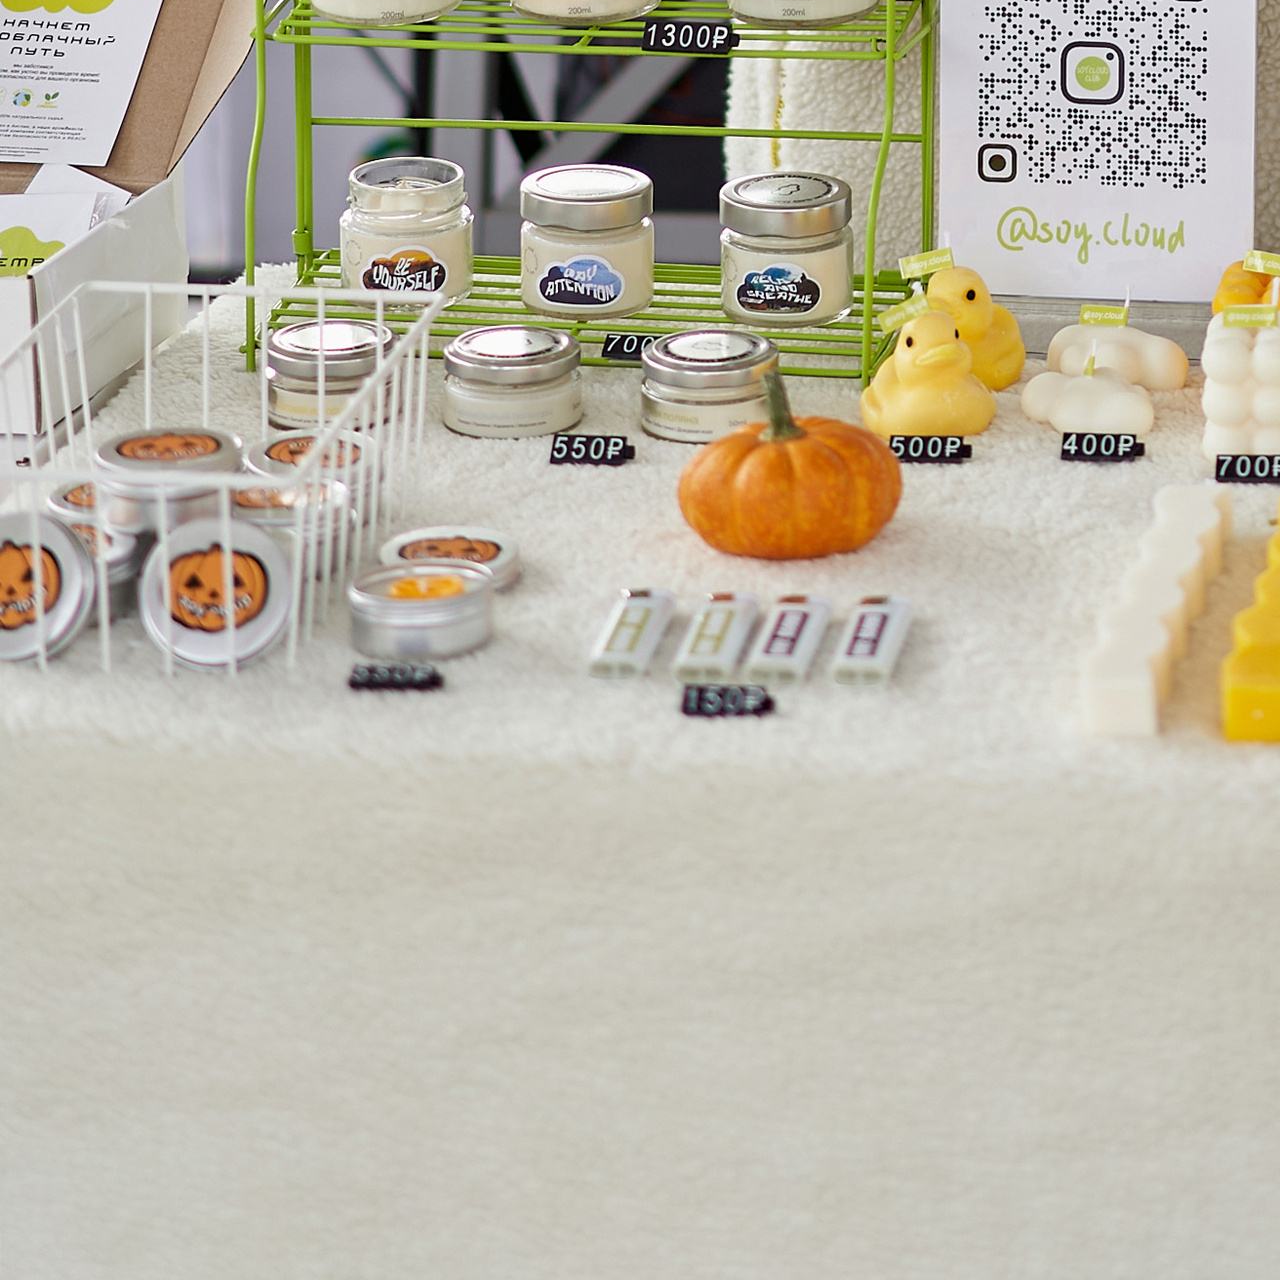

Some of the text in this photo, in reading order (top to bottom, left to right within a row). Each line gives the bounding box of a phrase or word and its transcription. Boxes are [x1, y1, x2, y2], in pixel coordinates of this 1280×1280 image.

[380, 10, 405, 20] 200ml
[567, 6, 592, 15] 200ml
[781, 8, 806, 17] 200ml
[3, 18, 91, 32] НАЧНЕМ
[0, 31, 116, 46] ОБЛАЧНЫЙ
[647, 23, 729, 49] 1300₽
[10, 46, 65, 58] ПУТЬ
[996, 205, 1186, 265] @soy.cloud
[393, 256, 415, 276] BE
[372, 264, 441, 291] YOURSELF
[544, 280, 615, 303] ATTENTION
[746, 289, 813, 305] BREATHE
[1083, 310, 1124, 321] @soy.cloud
[552, 436, 625, 460] 550₽
[891, 435, 962, 458] 500₽
[1062, 433, 1136, 457] 400₽
